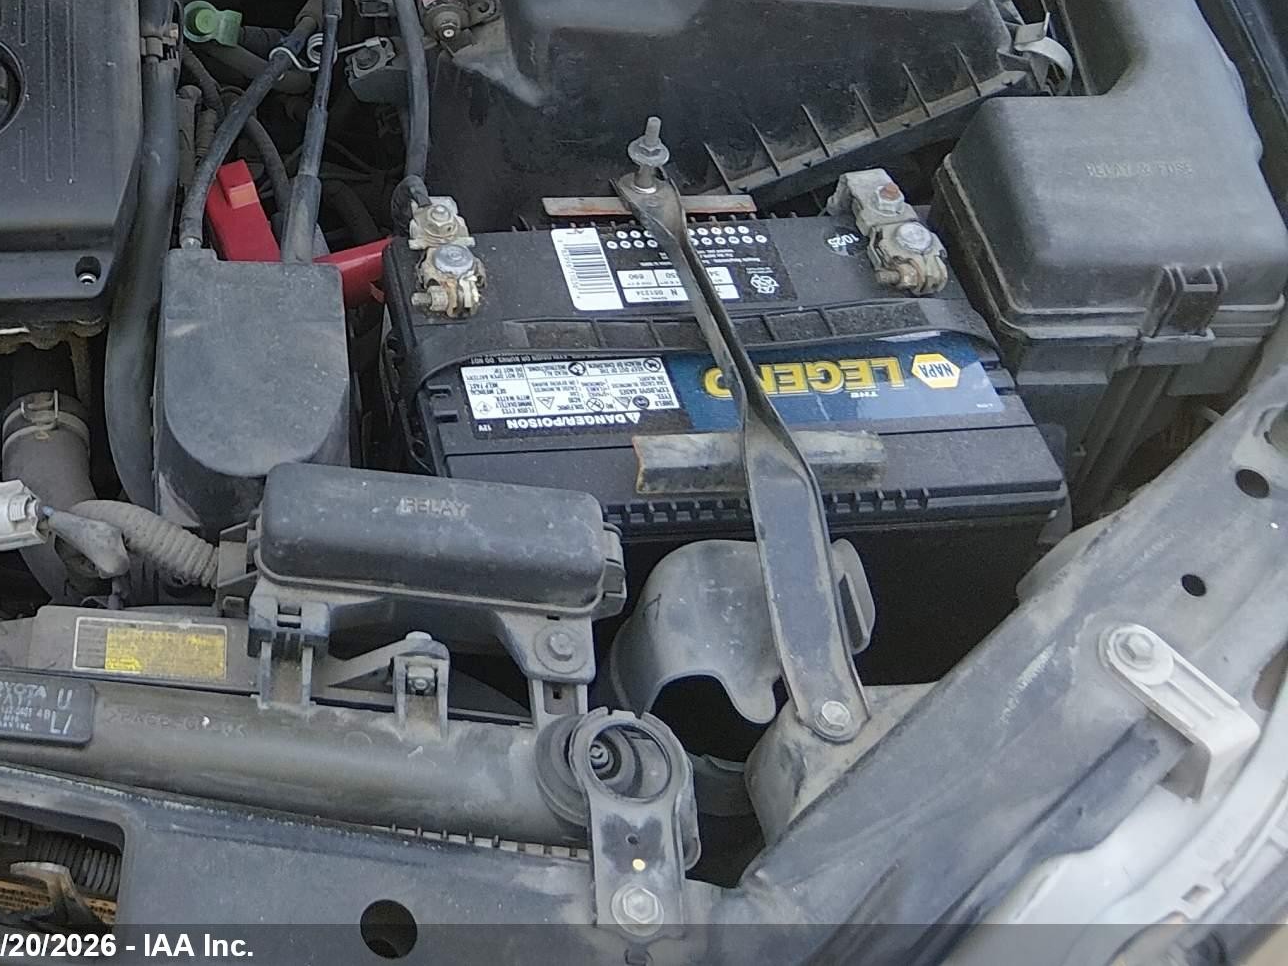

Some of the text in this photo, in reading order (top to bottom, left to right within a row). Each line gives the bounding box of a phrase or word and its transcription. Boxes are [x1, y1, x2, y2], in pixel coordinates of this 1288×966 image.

[827, 233, 860, 248] 10/25
[919, 362, 953, 379] NAPA
[850, 390, 878, 399] THE
[506, 414, 627, 429] DANGER/POISON
[397, 497, 469, 517] RELAY
